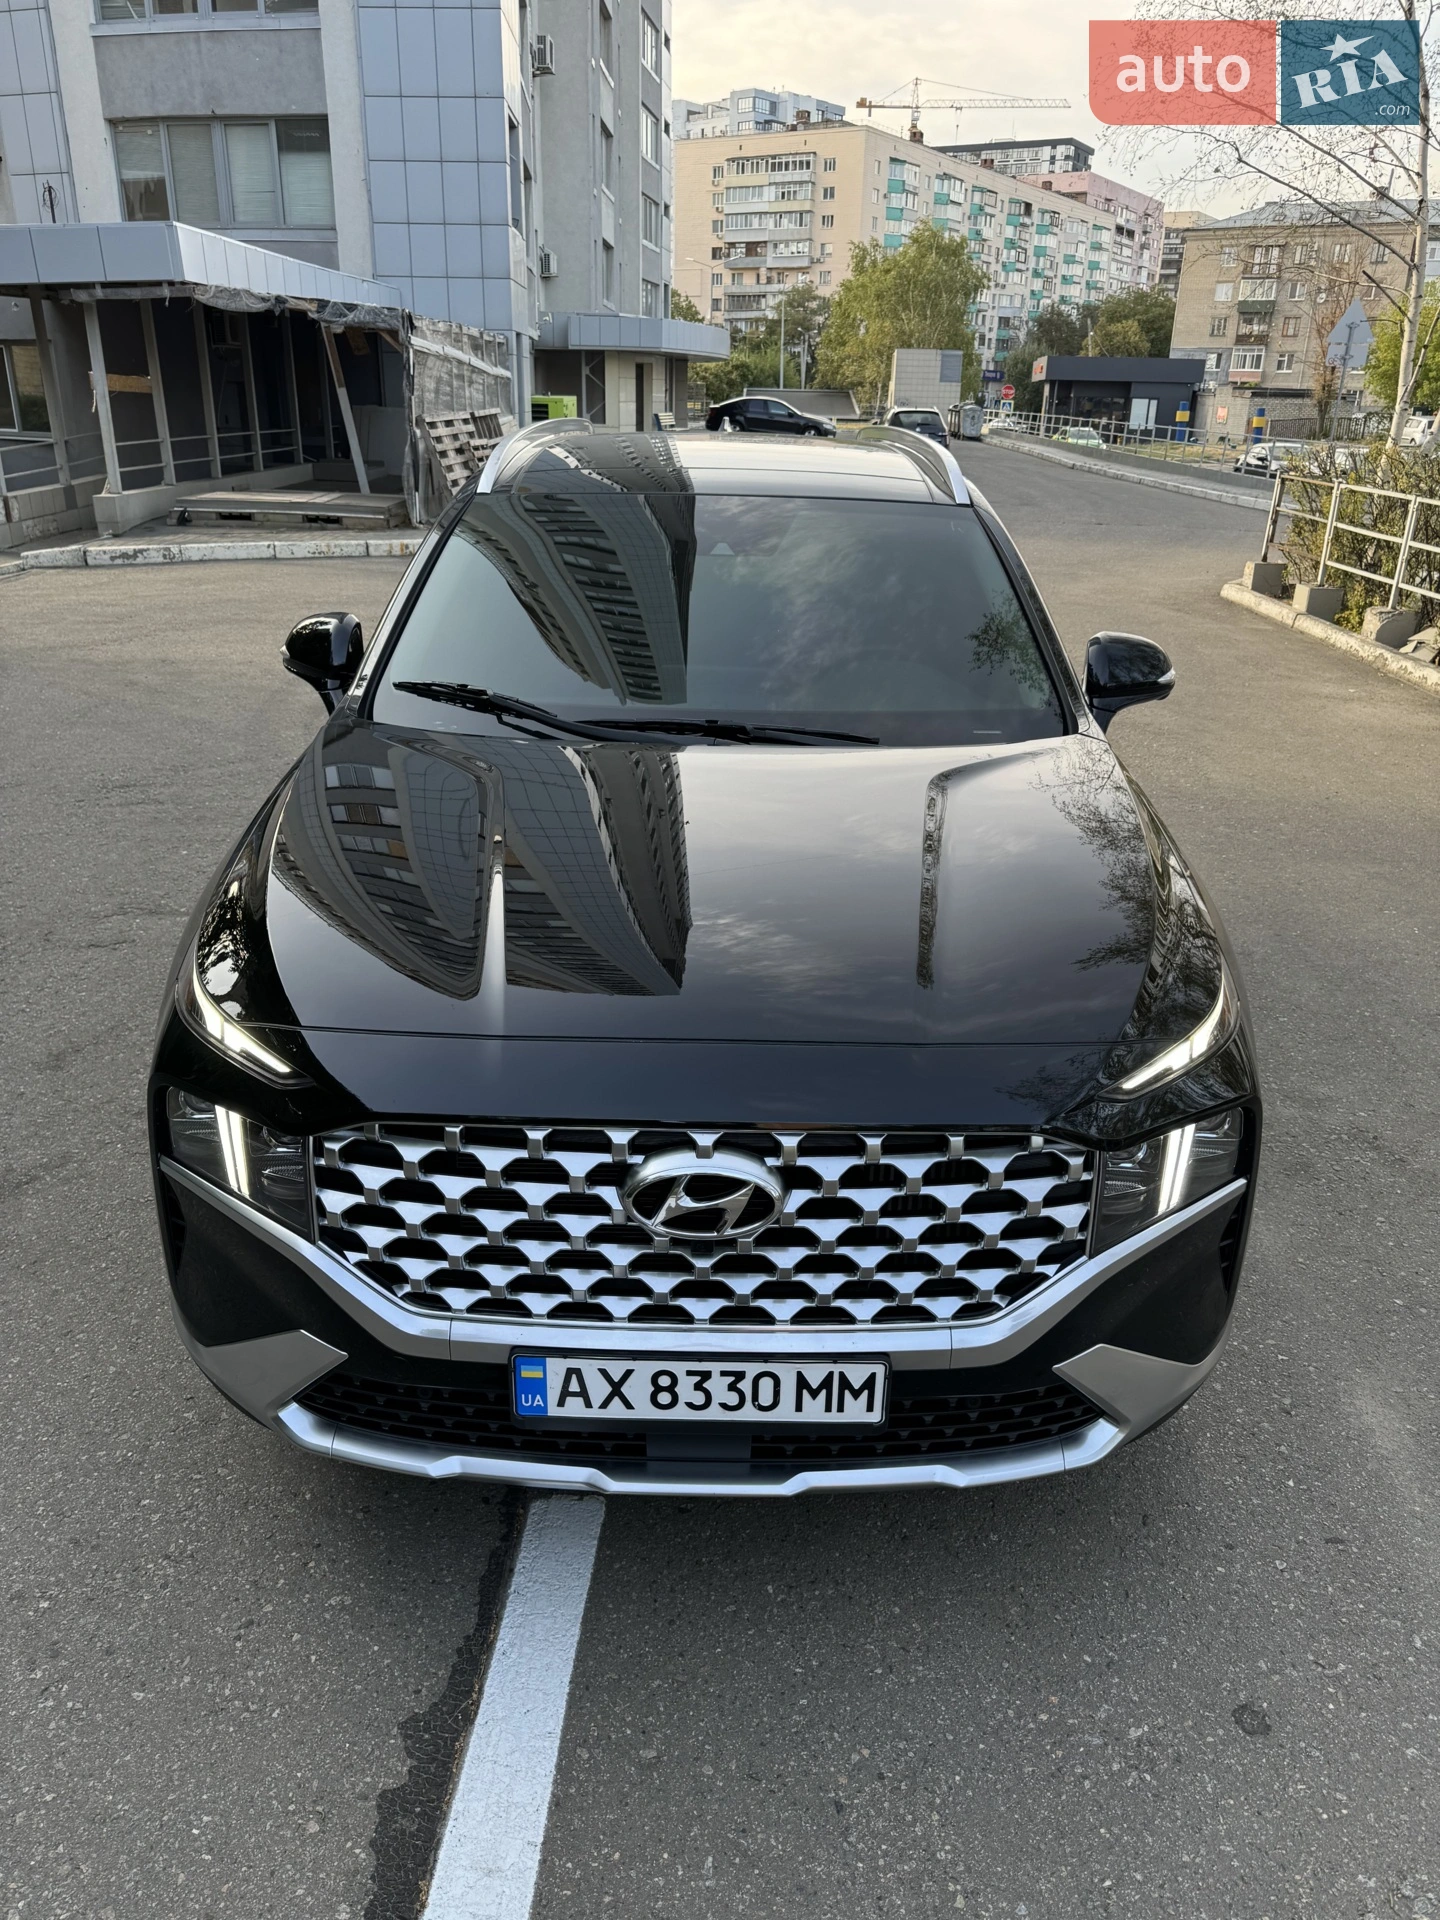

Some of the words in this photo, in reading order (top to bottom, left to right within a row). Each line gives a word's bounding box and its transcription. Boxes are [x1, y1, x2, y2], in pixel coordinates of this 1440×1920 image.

[521, 1393, 545, 1407] UA
[556, 1367, 636, 1410] AX
[650, 1369, 781, 1412] 8330
[795, 1370, 877, 1413] MM
